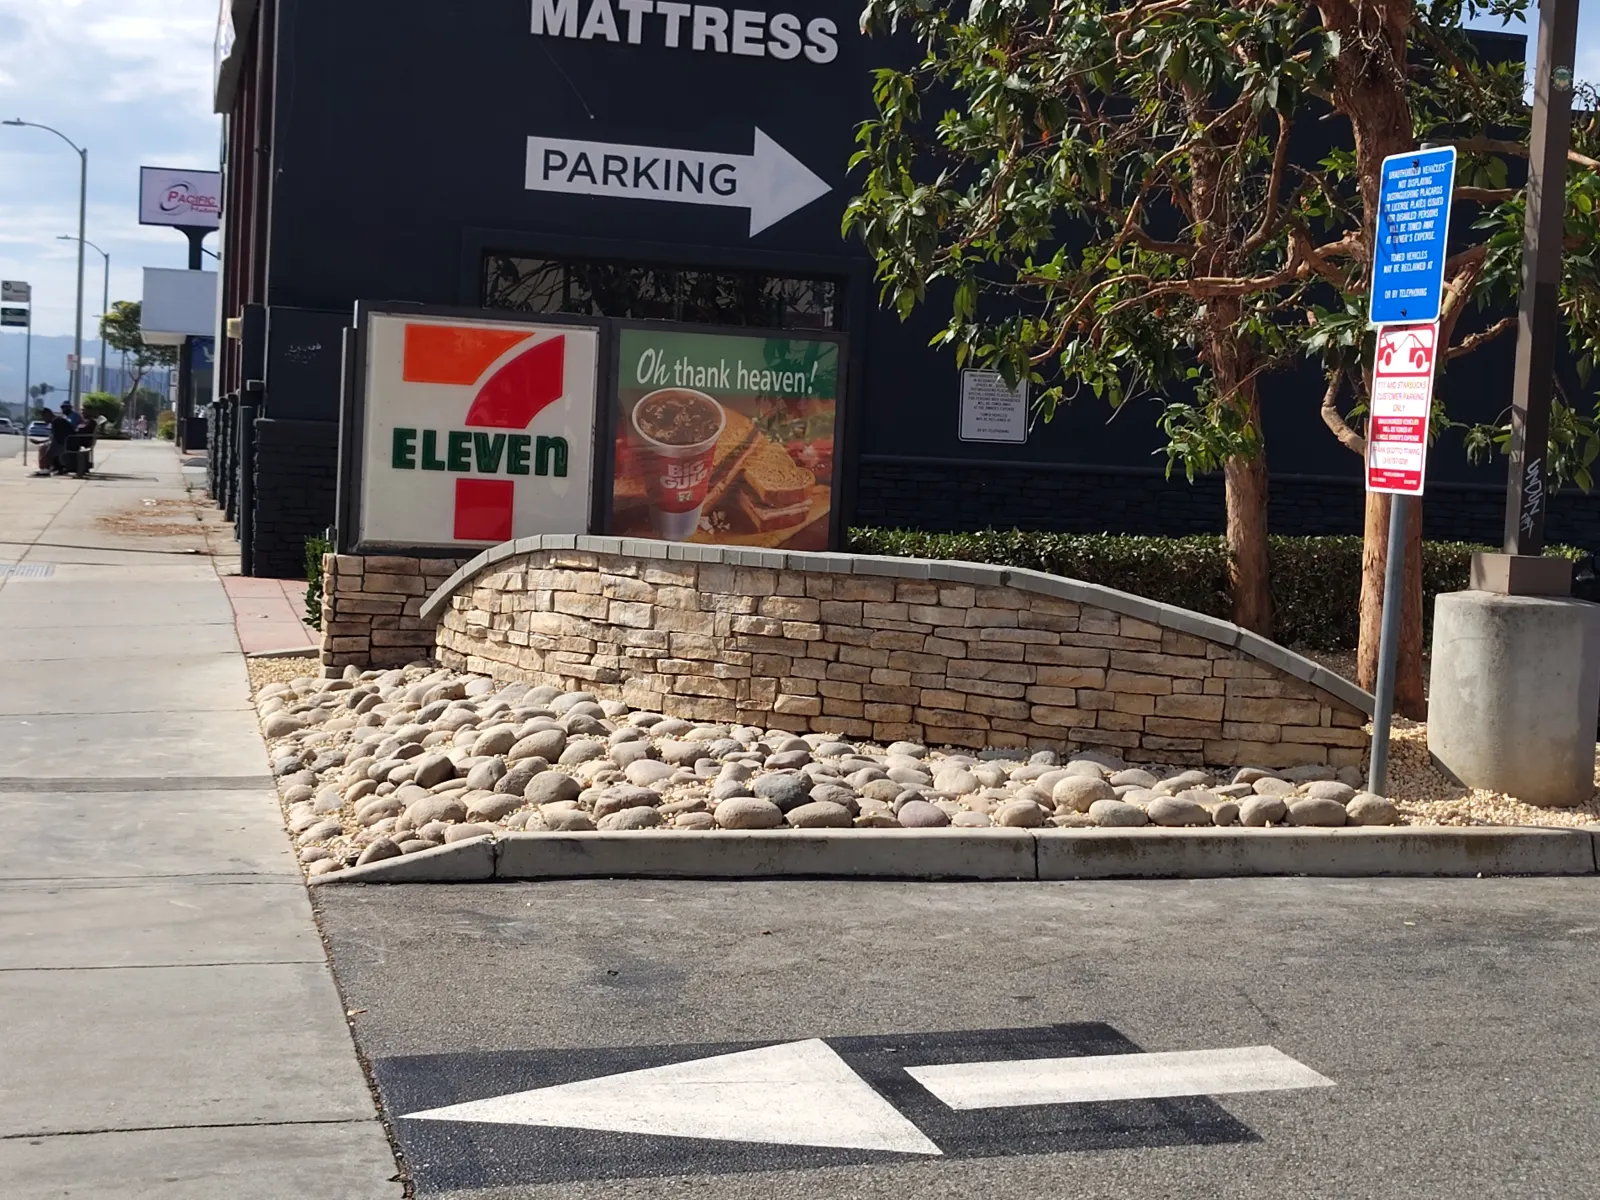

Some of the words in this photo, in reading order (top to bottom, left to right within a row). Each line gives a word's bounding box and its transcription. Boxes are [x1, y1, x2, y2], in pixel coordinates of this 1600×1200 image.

[530, 0, 839, 64] MATTRESS
[542, 148, 737, 196] PARKING
[1422, 164, 1445, 174] VEHICLES
[1408, 176, 1432, 188] DISPLAYING
[1420, 186, 1443, 196] PLACARDS
[168, 191, 216, 206] PACIFIC
[1392, 201, 1409, 212] LICENSE
[1410, 198, 1426, 209] PLATES
[1396, 211, 1416, 222] DISABLED
[1418, 208, 1438, 219] PERSONS
[1400, 223, 1406, 232] BE
[1408, 222, 1422, 231] TOWED
[1386, 236, 1392, 244] AT
[1393, 233, 1413, 243] OWNER'S
[1390, 252, 1405, 262] TOWED
[1406, 250, 1428, 260] VEHICLES
[1384, 264, 1392, 274] MAY
[1393, 264, 1400, 272] BE
[1401, 261, 1426, 272] RECLAIMED
[1427, 260, 1433, 270] AT
[1384, 290, 1391, 299] OR
[1392, 289, 1398, 298] BY
[1399, 288, 1428, 298] TELEPHONING
[636, 347, 671, 386] Oh
[674, 356, 730, 389] thank
[737, 360, 818, 395] heaven!
[1377, 392, 1402, 400] CUSTOMER
[1403, 392, 1424, 400] PARKING
[1392, 404, 1406, 412] ONLY
[660, 468, 708, 490] GULP
